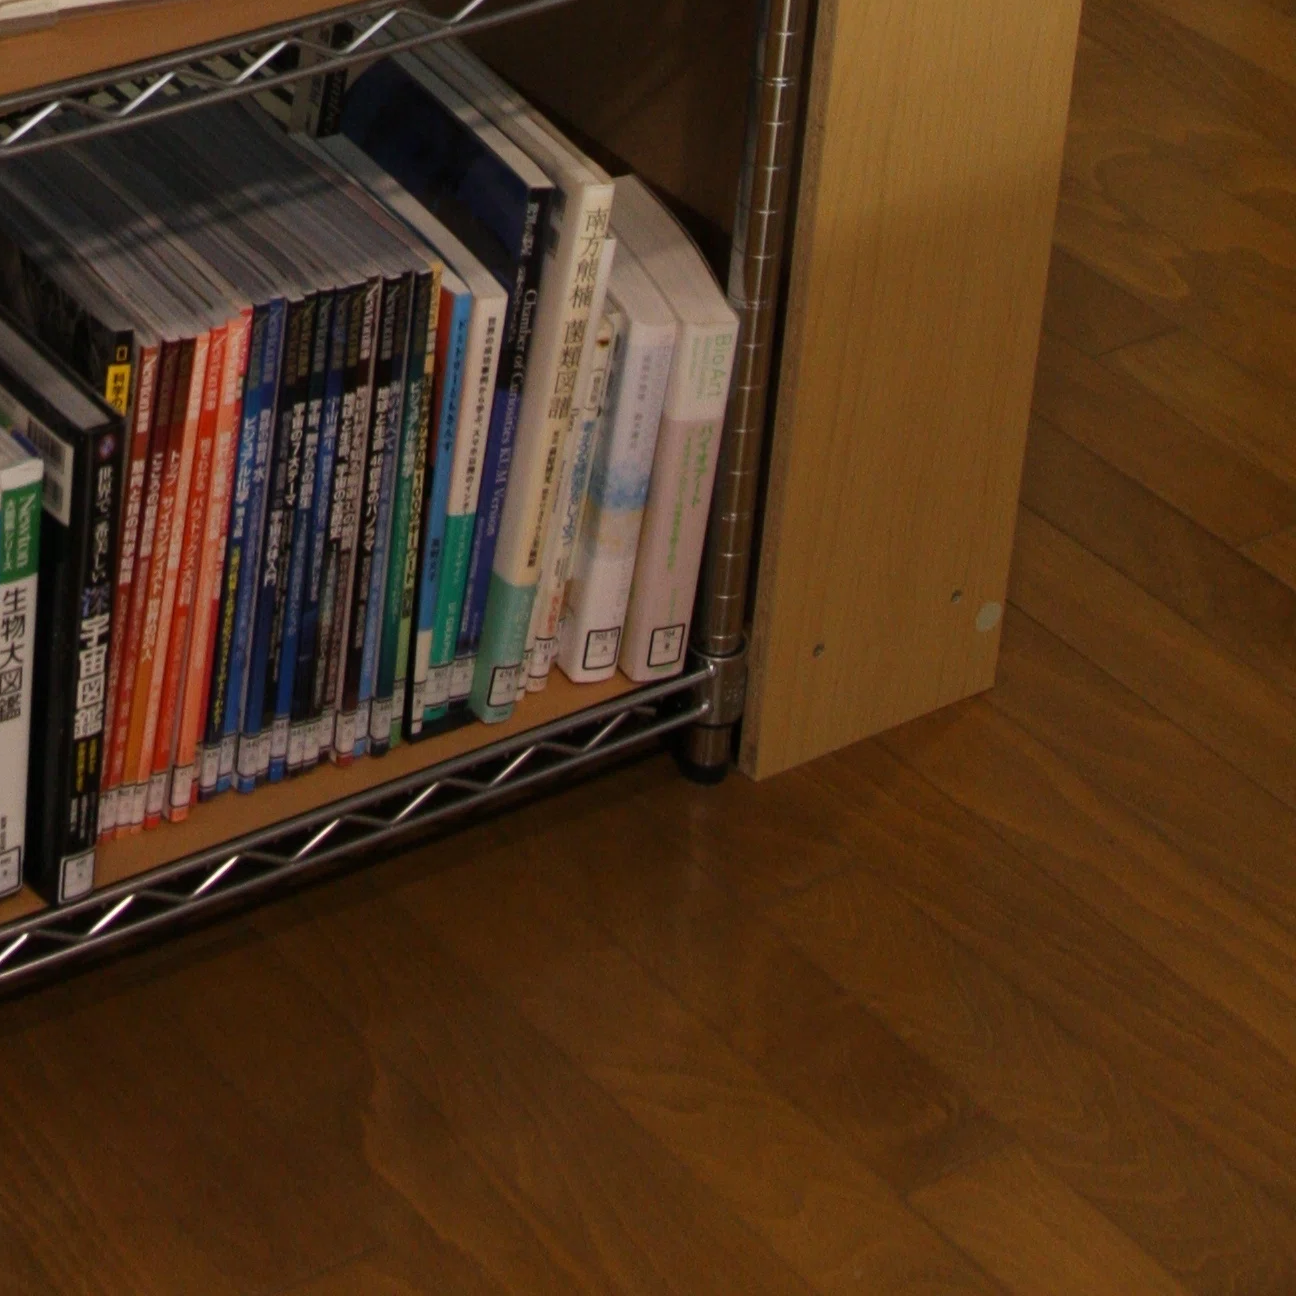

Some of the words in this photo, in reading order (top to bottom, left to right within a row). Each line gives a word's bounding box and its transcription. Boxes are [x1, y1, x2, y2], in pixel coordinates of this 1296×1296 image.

[567, 207, 610, 309] 南方熊楠
[546, 318, 584, 420] 菌類図譜
[19, 493, 38, 570] Newton
